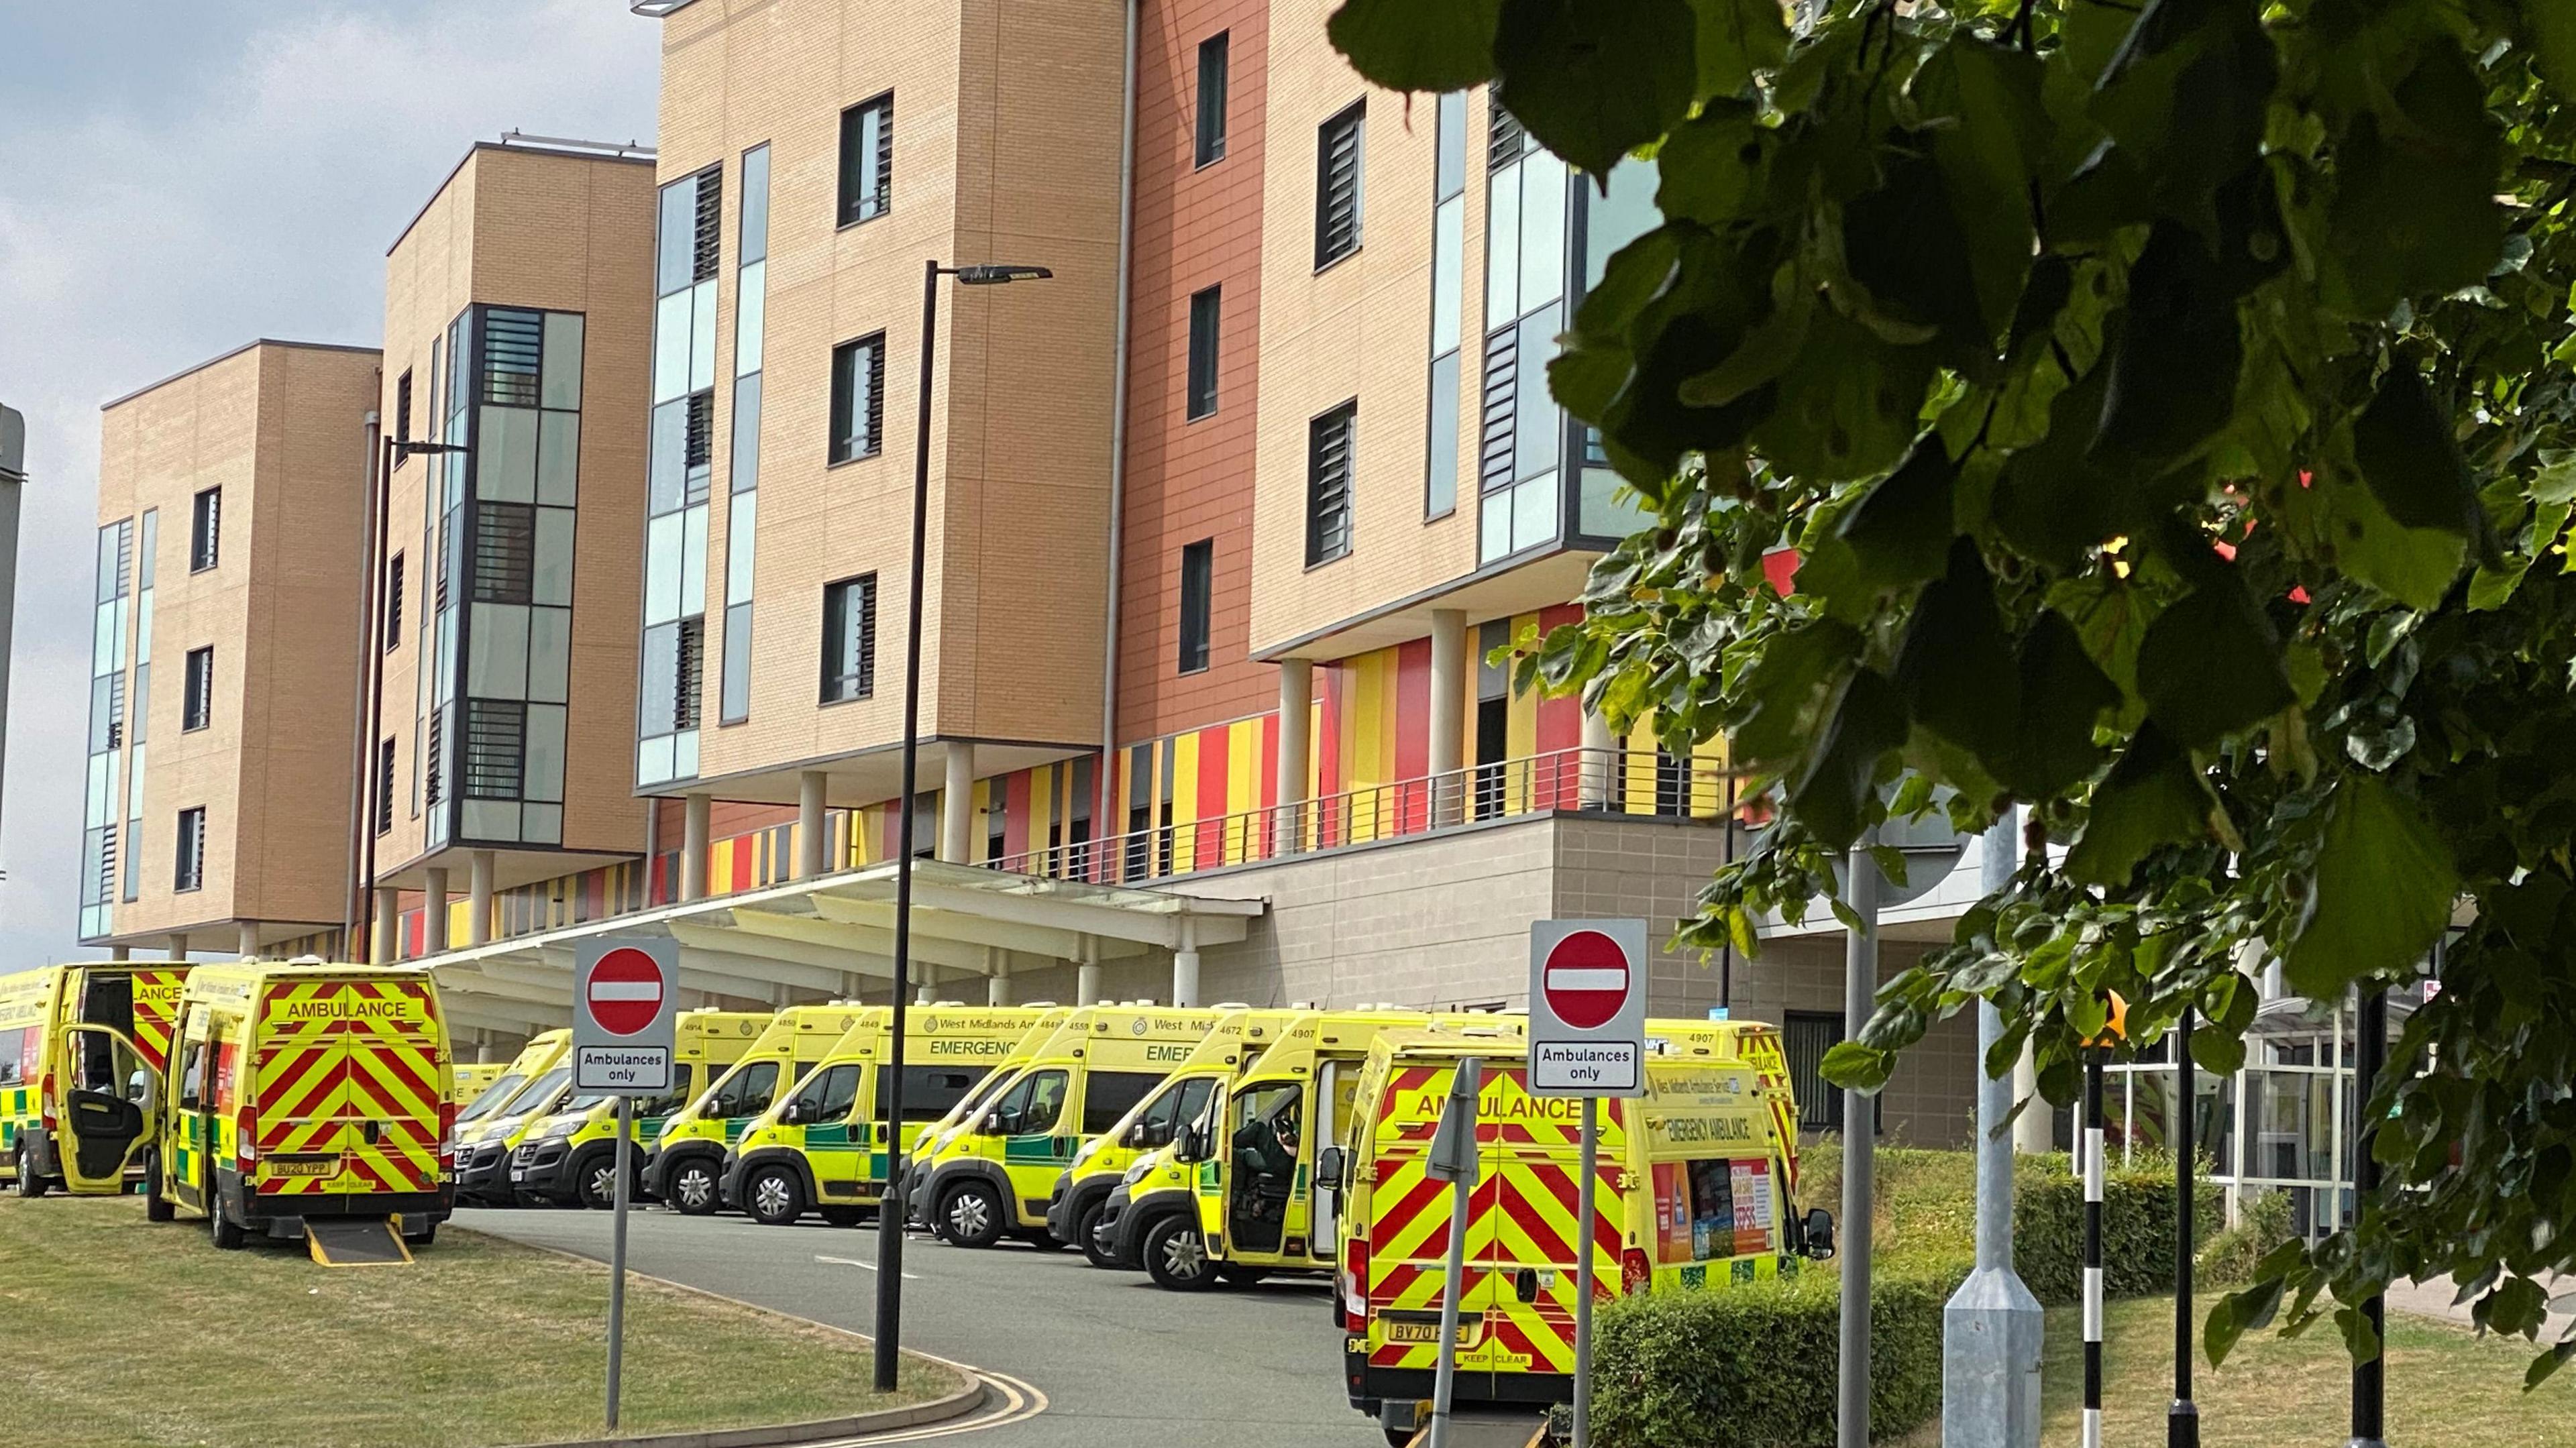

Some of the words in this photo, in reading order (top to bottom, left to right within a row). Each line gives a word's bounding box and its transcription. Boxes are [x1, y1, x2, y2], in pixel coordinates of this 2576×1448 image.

[287, 1002, 407, 1017] AMBULANCE
[941, 1019, 965, 1028] West
[969, 1019, 1016, 1029] Midlands
[1155, 1019, 1183, 1030] West
[1220, 1026, 1242, 1035] 4672
[1291, 1029, 1316, 1038] 4907
[1689, 1033, 1714, 1042] 4907
[930, 1041, 1018, 1055] EMERGENC
[584, 1053, 661, 1065] Ambulances
[1542, 1048, 1629, 1062] Ambulances
[608, 1069, 635, 1082] only
[1570, 1066, 1600, 1081] only
[1666, 1118, 1707, 1141] EMERGENCY
[1709, 1117, 1750, 1140] AMBULANCE
[307, 1163, 325, 1173] YPP
[1396, 1325, 1432, 1339] BV70
[1464, 1354, 1488, 1362] KEEP
[1495, 1355, 1527, 1363] CLEAR
